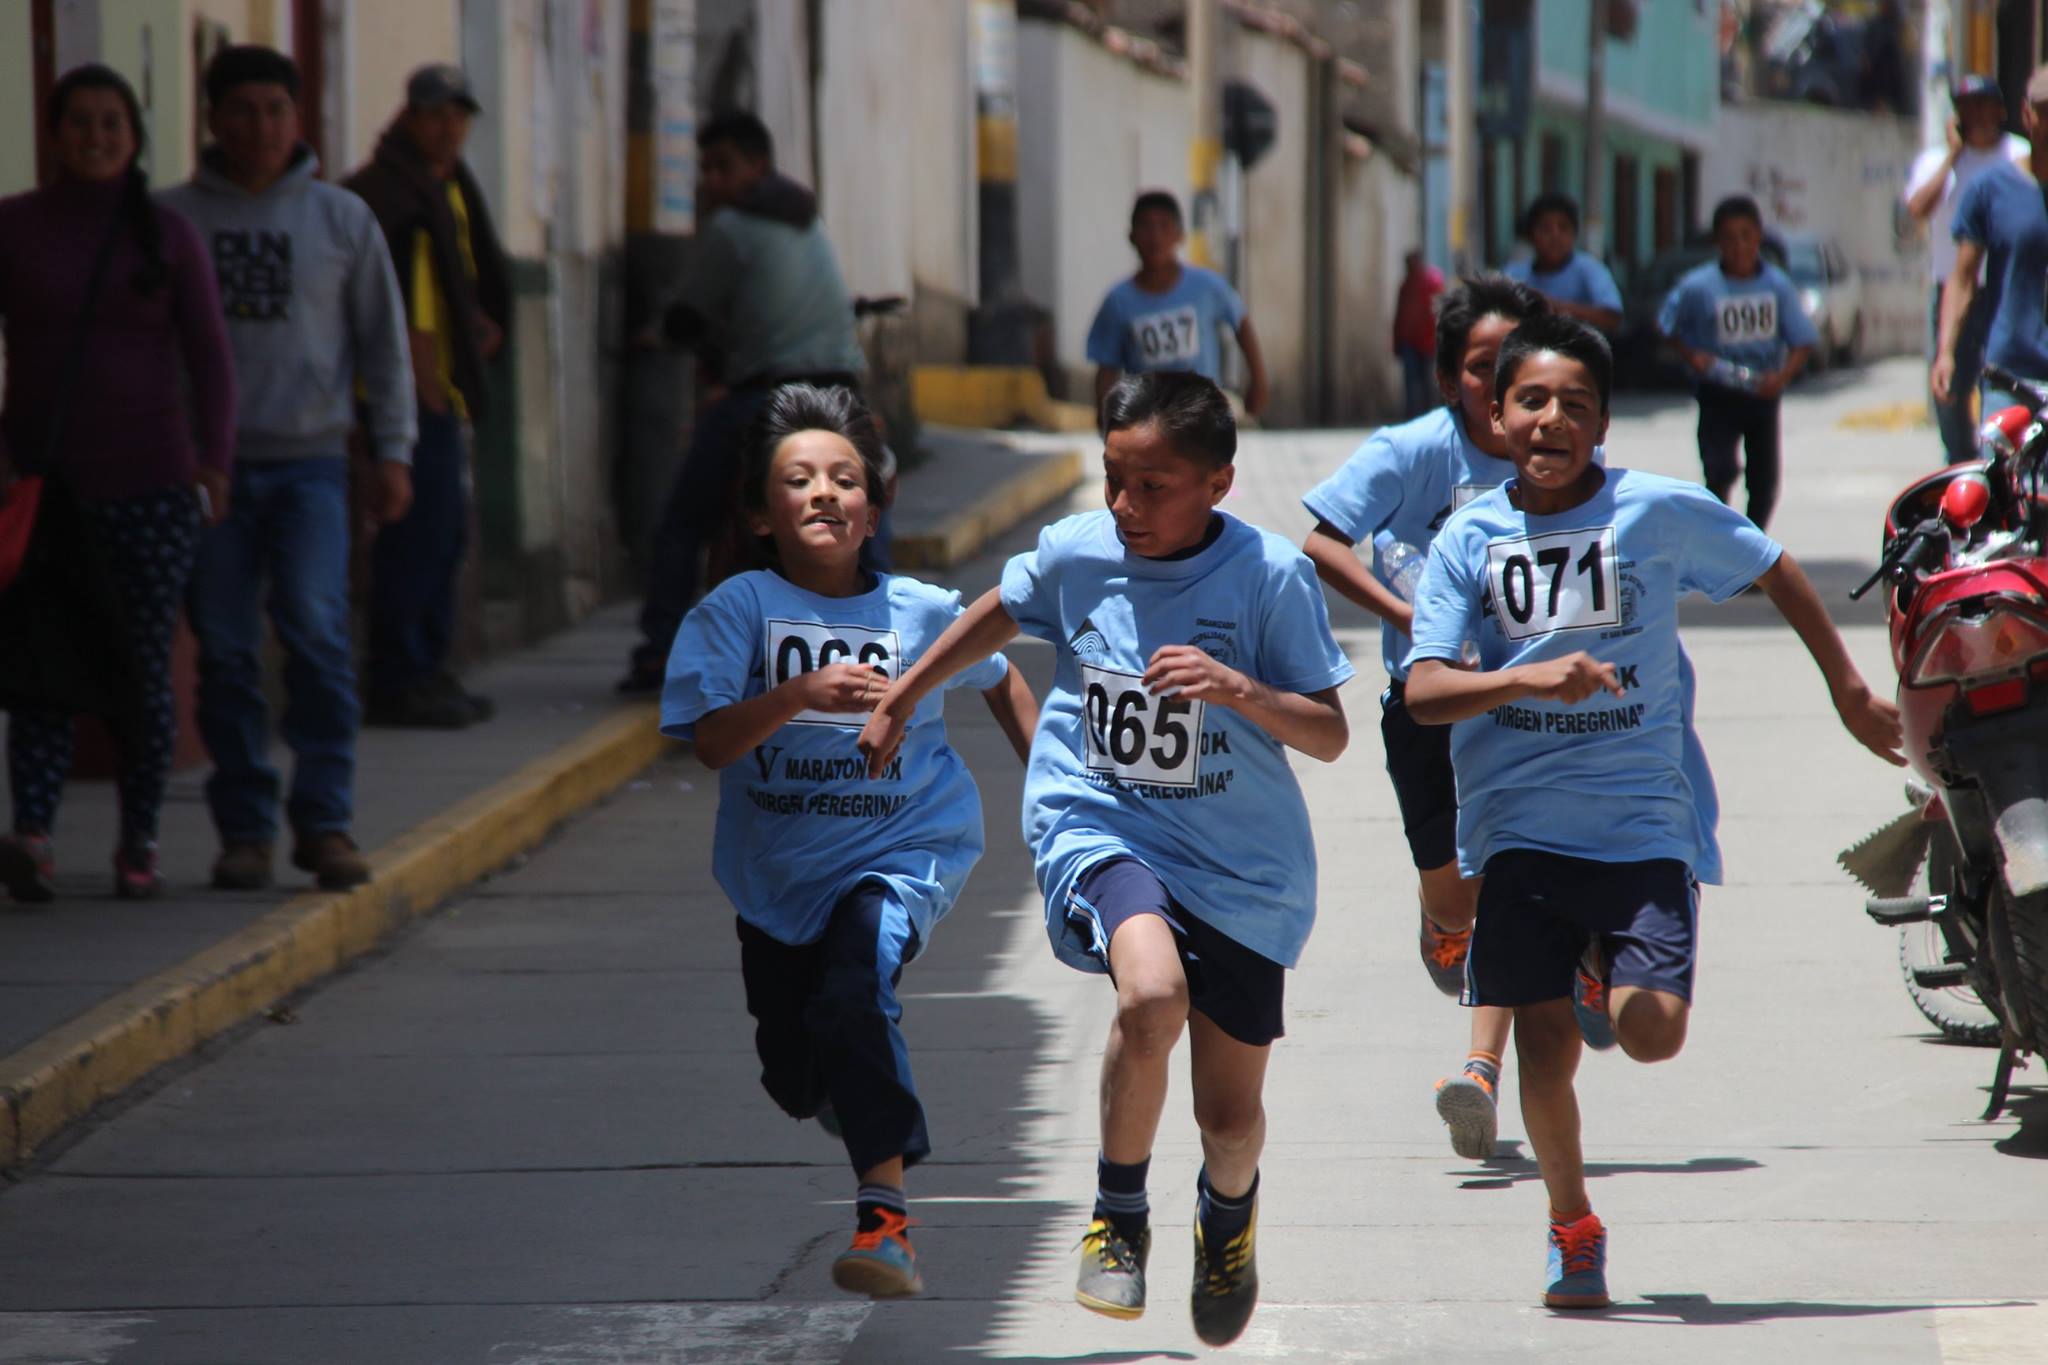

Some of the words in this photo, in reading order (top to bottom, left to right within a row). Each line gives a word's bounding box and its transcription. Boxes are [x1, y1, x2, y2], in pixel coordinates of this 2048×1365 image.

[1141, 317, 1193, 355] 037
[1723, 302, 1772, 334] 098
[1503, 541, 1606, 624] 071
[1087, 682, 1191, 770] 065
[1545, 703, 1645, 734] PEREGRINA"
[1201, 731, 1232, 755] 0K
[755, 744, 784, 784] V
